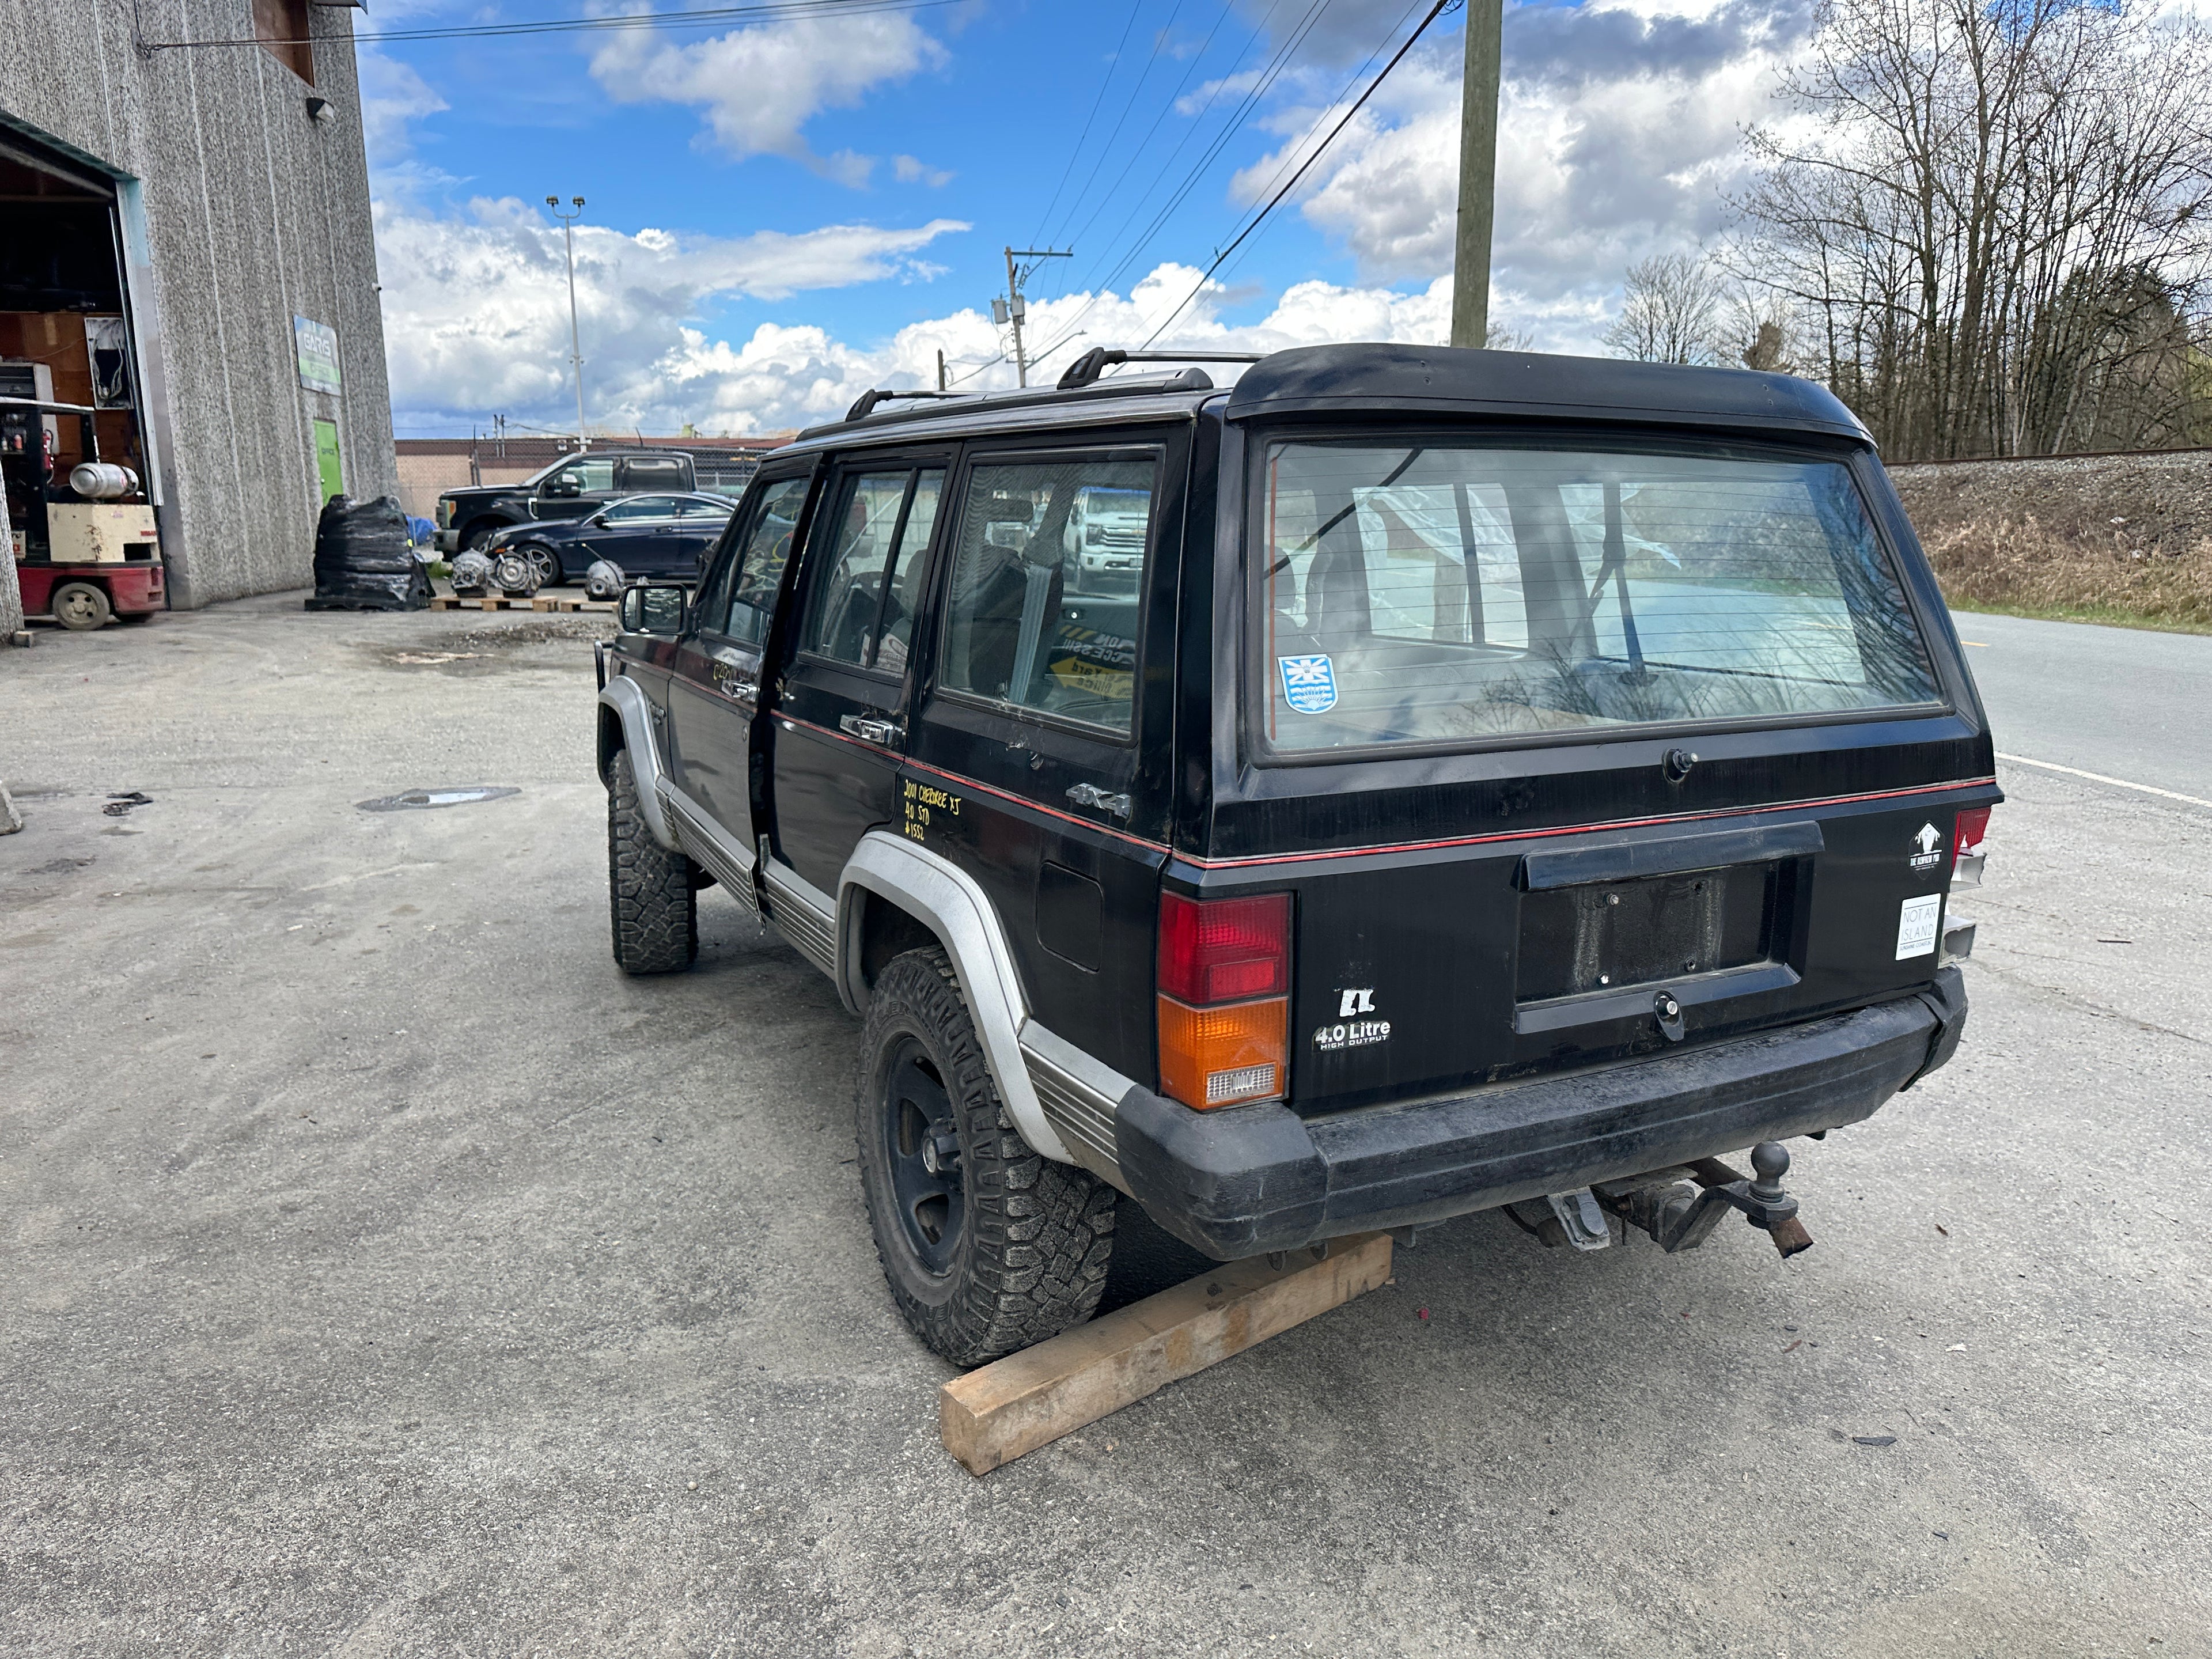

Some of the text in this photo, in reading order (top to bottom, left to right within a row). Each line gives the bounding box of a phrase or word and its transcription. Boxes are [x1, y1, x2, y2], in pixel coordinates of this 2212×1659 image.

[904, 779, 962, 816] 2001 CHEROKEE XJ
[918, 805, 930, 826] STD
[1903, 906, 1937, 923] NOT AN
[1901, 924, 1934, 941] ISLAND
[1315, 1021, 1391, 1044] 4.0 Litre
[1320, 1035, 1388, 1050] HIGH OUTPUT
